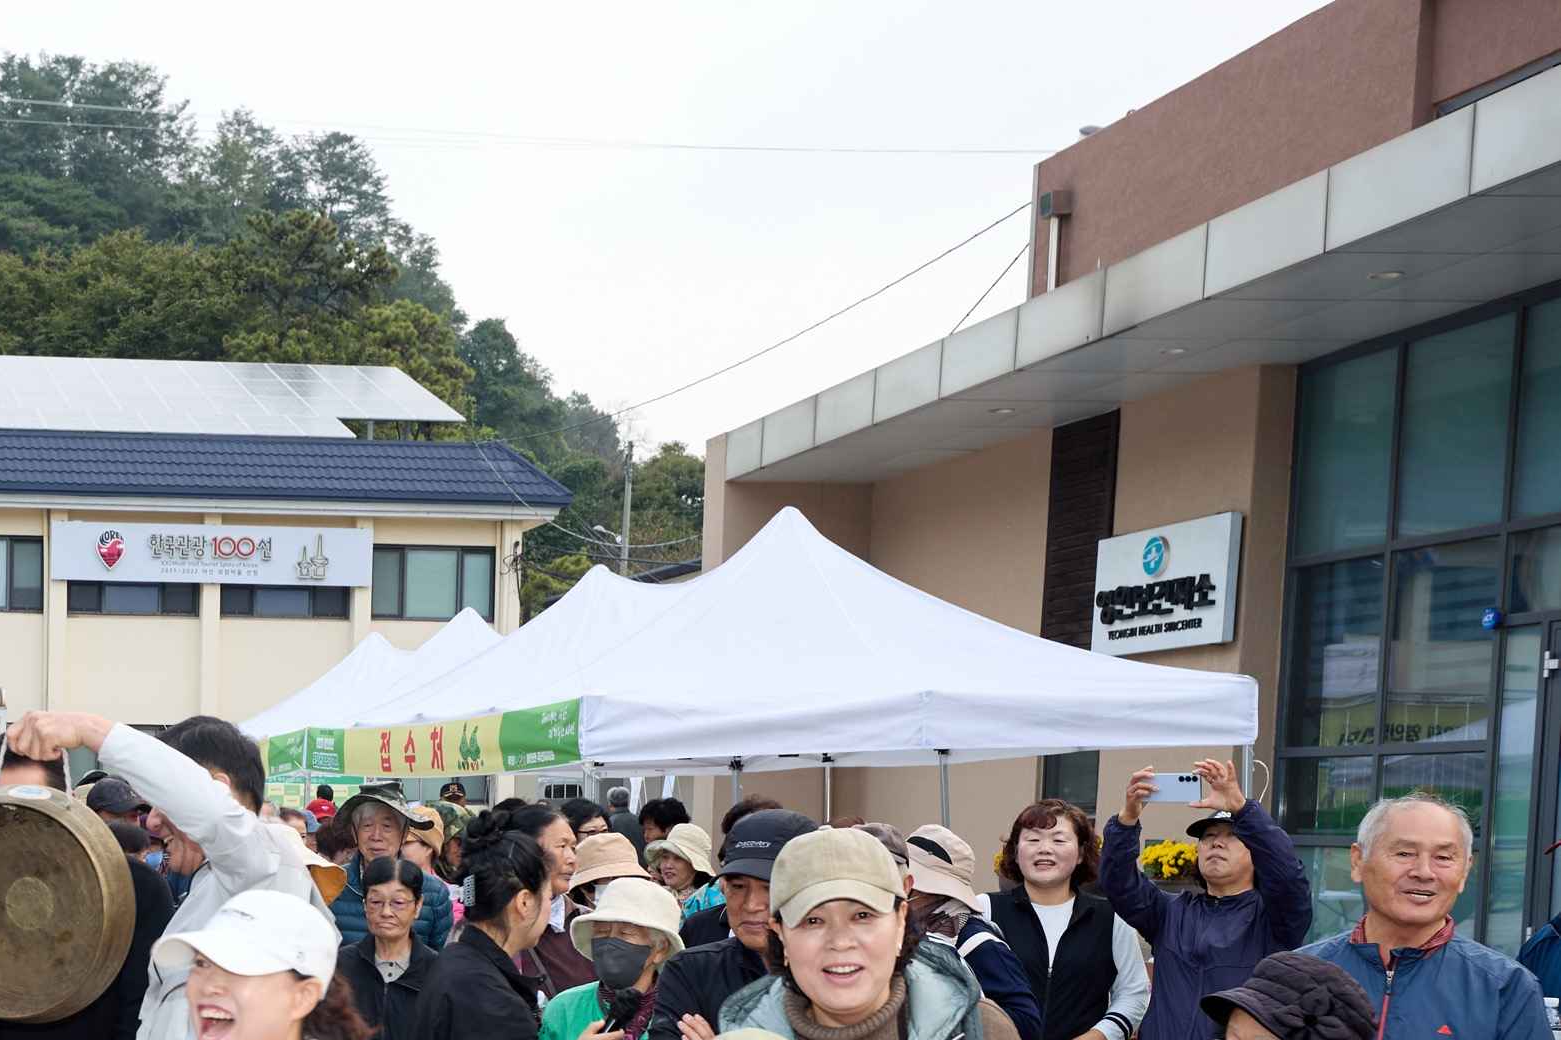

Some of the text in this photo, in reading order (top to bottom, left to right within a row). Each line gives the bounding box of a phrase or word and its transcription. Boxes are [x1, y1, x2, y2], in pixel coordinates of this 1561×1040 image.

[150, 533, 271, 561] 한국관광 100선
[1096, 574, 1216, 624] 영인보건지소
[1108, 618, 1202, 640] YEONGIN HEALTH SUBCENTER
